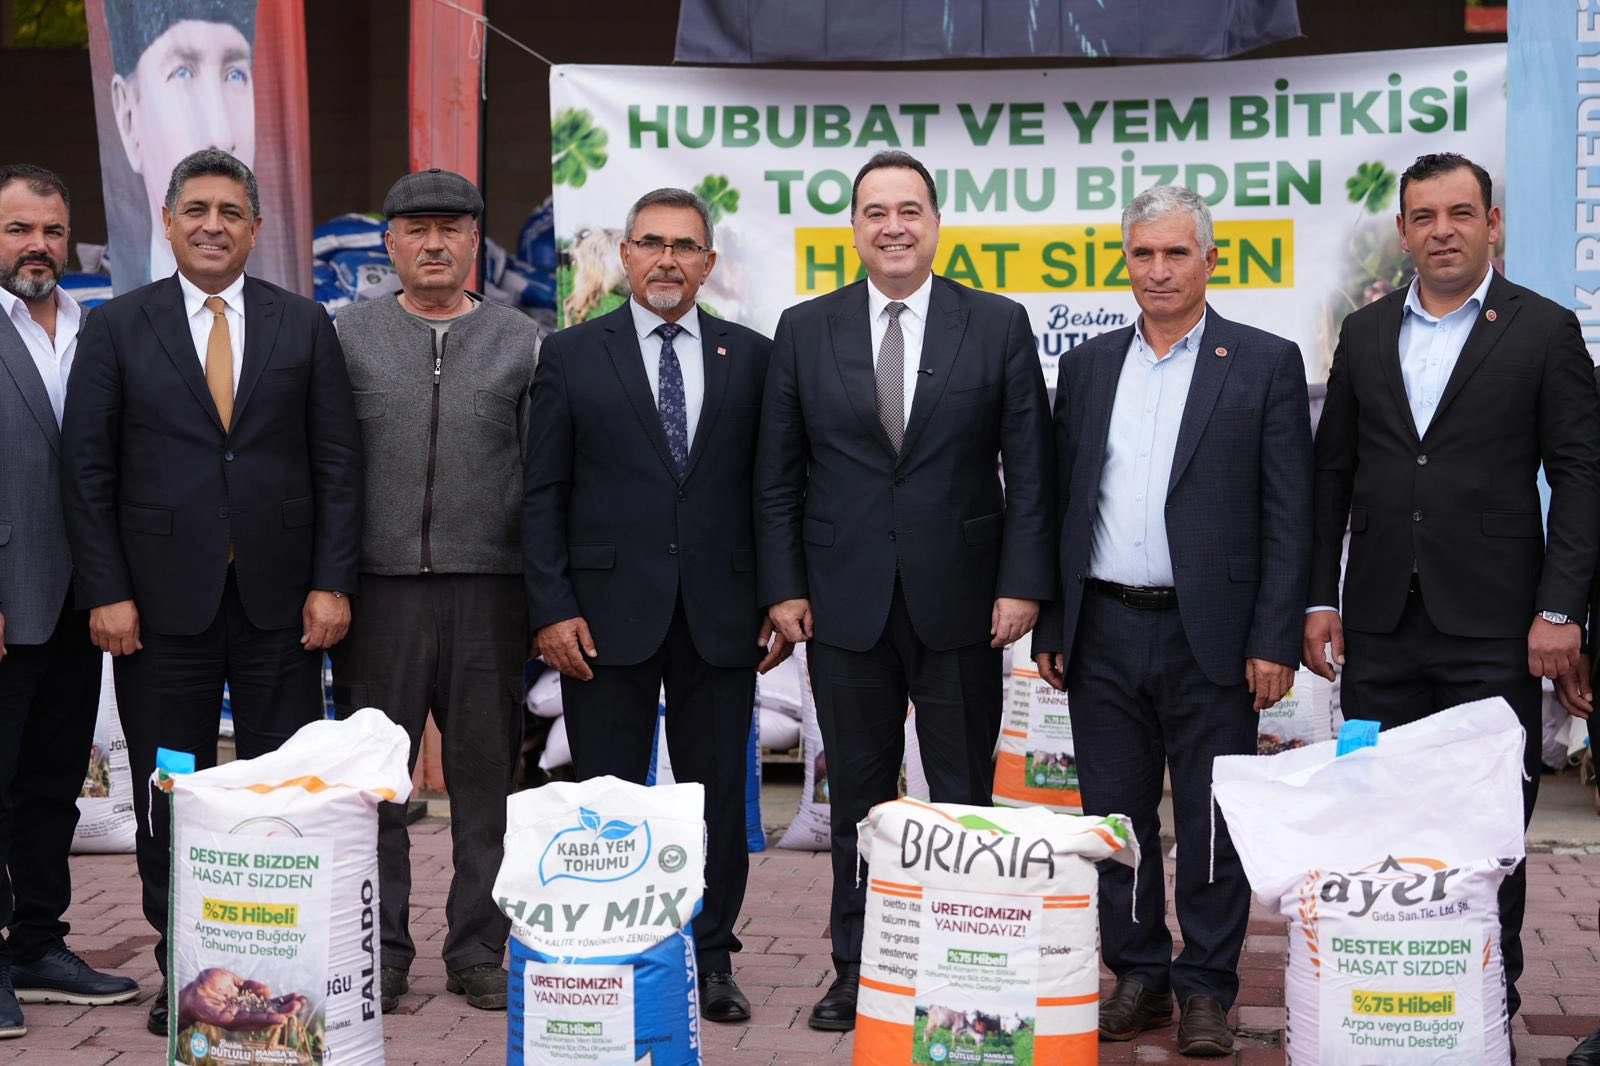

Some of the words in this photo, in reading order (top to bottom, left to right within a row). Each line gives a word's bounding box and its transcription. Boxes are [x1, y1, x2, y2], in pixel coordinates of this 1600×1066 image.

[628, 102, 940, 149] HUBUBAT
[957, 101, 1046, 147] VE
[1053, 97, 1209, 146] YEM
[1229, 70, 1469, 140] BİTKİSİ
[764, 167, 1055, 215] TOMU
[805, 241, 1019, 290] HAT
[1041, 226, 1282, 288] SİZEN
[1047, 303, 1129, 330] Besim
[190, 846, 250, 868] DESTEK
[557, 842, 600, 856] KABA
[605, 839, 636, 854] YEM
[901, 818, 1055, 880] BRIXIA
[564, 855, 629, 873] TOHUMU
[193, 865, 244, 886] HASAT
[204, 902, 238, 921] %75
[242, 906, 295, 924] Hibeli
[498, 896, 590, 933] HAY
[602, 884, 688, 932] MİX
[1439, 904, 1456, 917] Ltd.
[195, 920, 221, 936] Arpa
[223, 929, 253, 942] veya
[256, 929, 307, 944] Buğday
[935, 918, 1026, 938] YANINDAYIZ!
[200, 936, 246, 955] Tohumu
[250, 943, 298, 959] Desteği
[361, 878, 375, 1022] FALADO
[1332, 937, 1404, 955] DESTEK
[1338, 957, 1399, 976] HASAT
[534, 989, 619, 1006] YANINDAYIZ!
[1354, 995, 1394, 1013] %75
[1398, 995, 1453, 1013] Hibeli
[569, 1023, 602, 1035] Hibeli
[1341, 1017, 1375, 1032] Arpa
[1378, 1021, 1411, 1034] veya
[1413, 1019, 1464, 1035] Buğday
[1350, 1033, 1405, 1047] Tohumu
[1408, 1033, 1458, 1049] Desteği
[211, 1046, 251, 1061] DUTLULU
